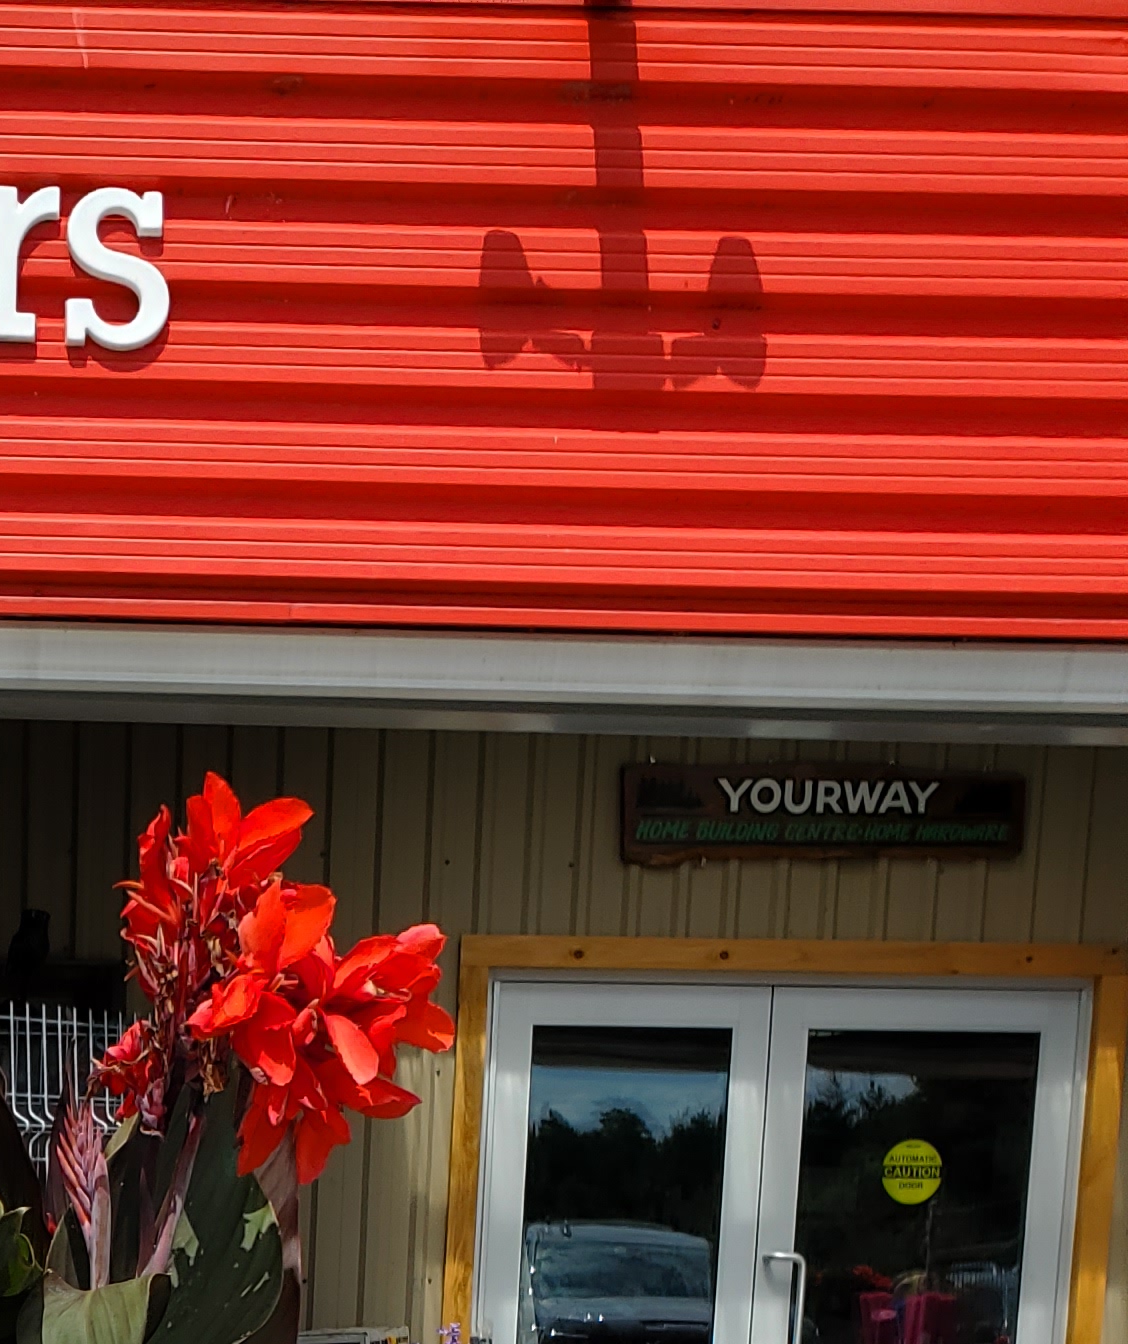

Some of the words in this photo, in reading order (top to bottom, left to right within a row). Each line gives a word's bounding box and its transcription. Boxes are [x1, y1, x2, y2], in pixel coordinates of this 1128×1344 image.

[718, 777, 940, 815] YOURWAY
[635, 820, 690, 841] HOME
[695, 821, 779, 841] BUILDING
[884, 1166, 940, 1178] CAUTION
